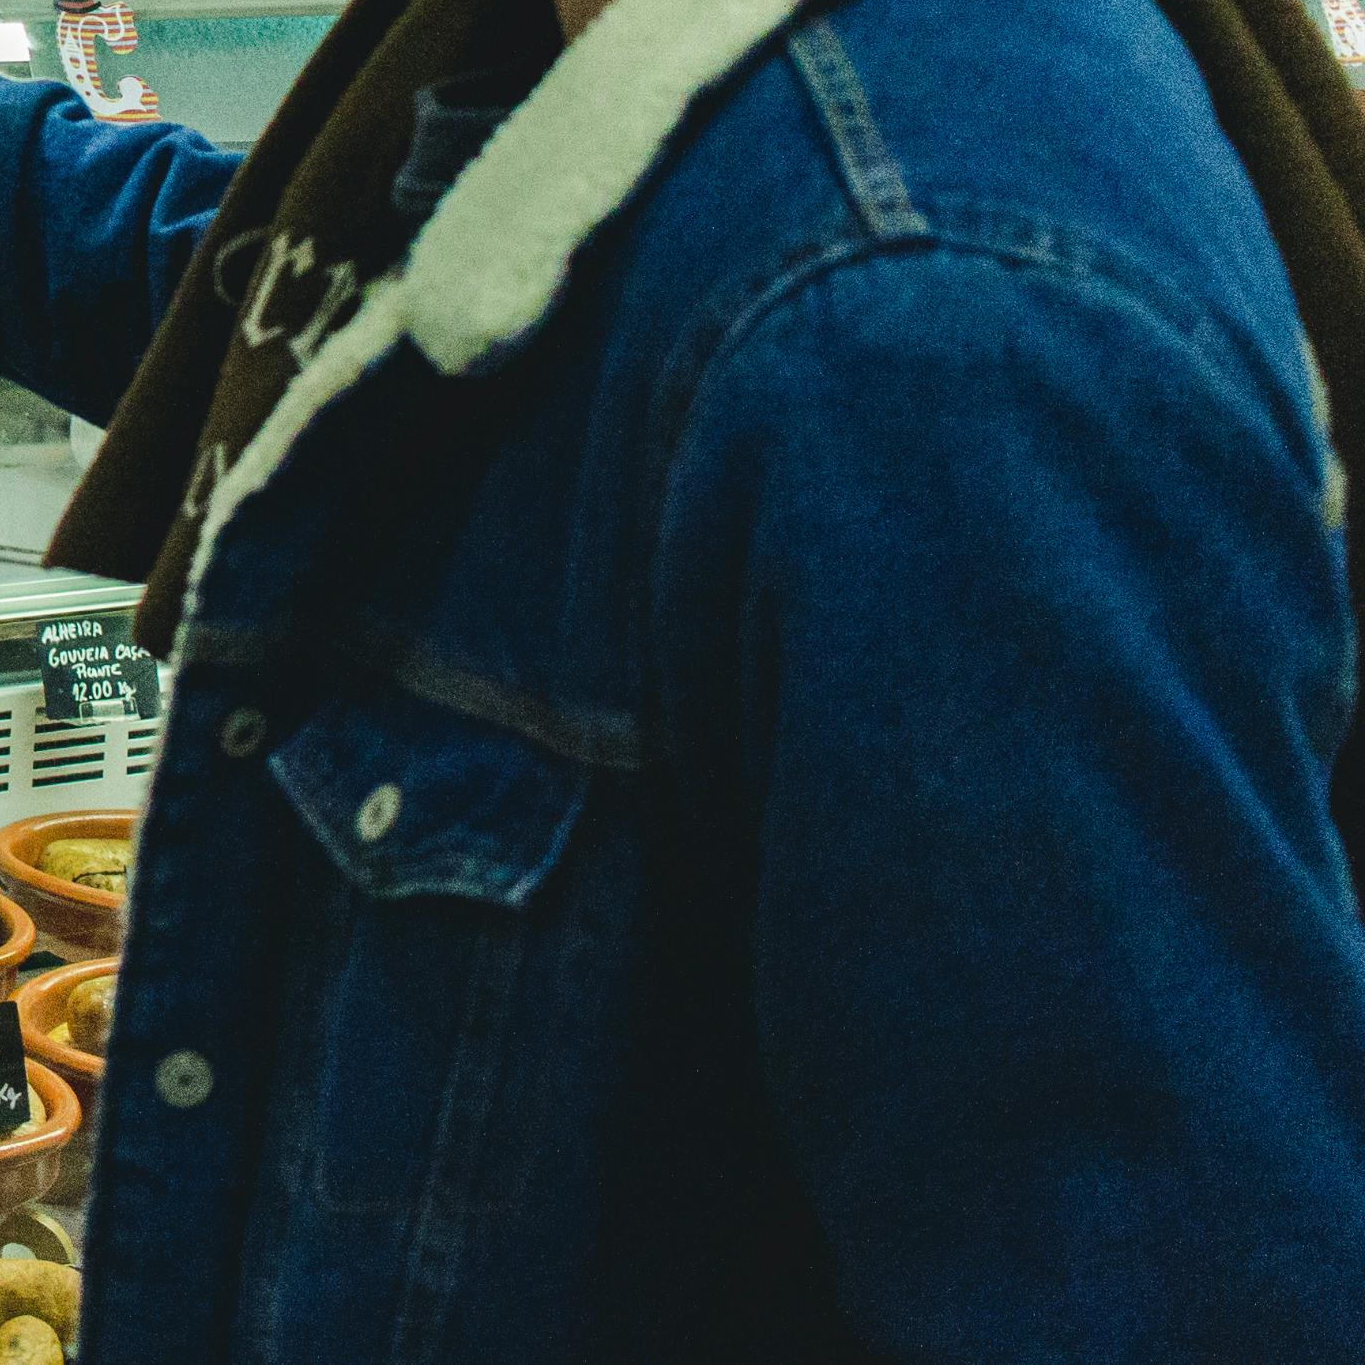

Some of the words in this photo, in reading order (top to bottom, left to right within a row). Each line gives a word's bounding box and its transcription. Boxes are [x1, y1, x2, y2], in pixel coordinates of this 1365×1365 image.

[42, 620, 103, 645] ALHEIRA
[49, 646, 109, 668] GOUVEIA
[72, 680, 113, 702] 12.00
